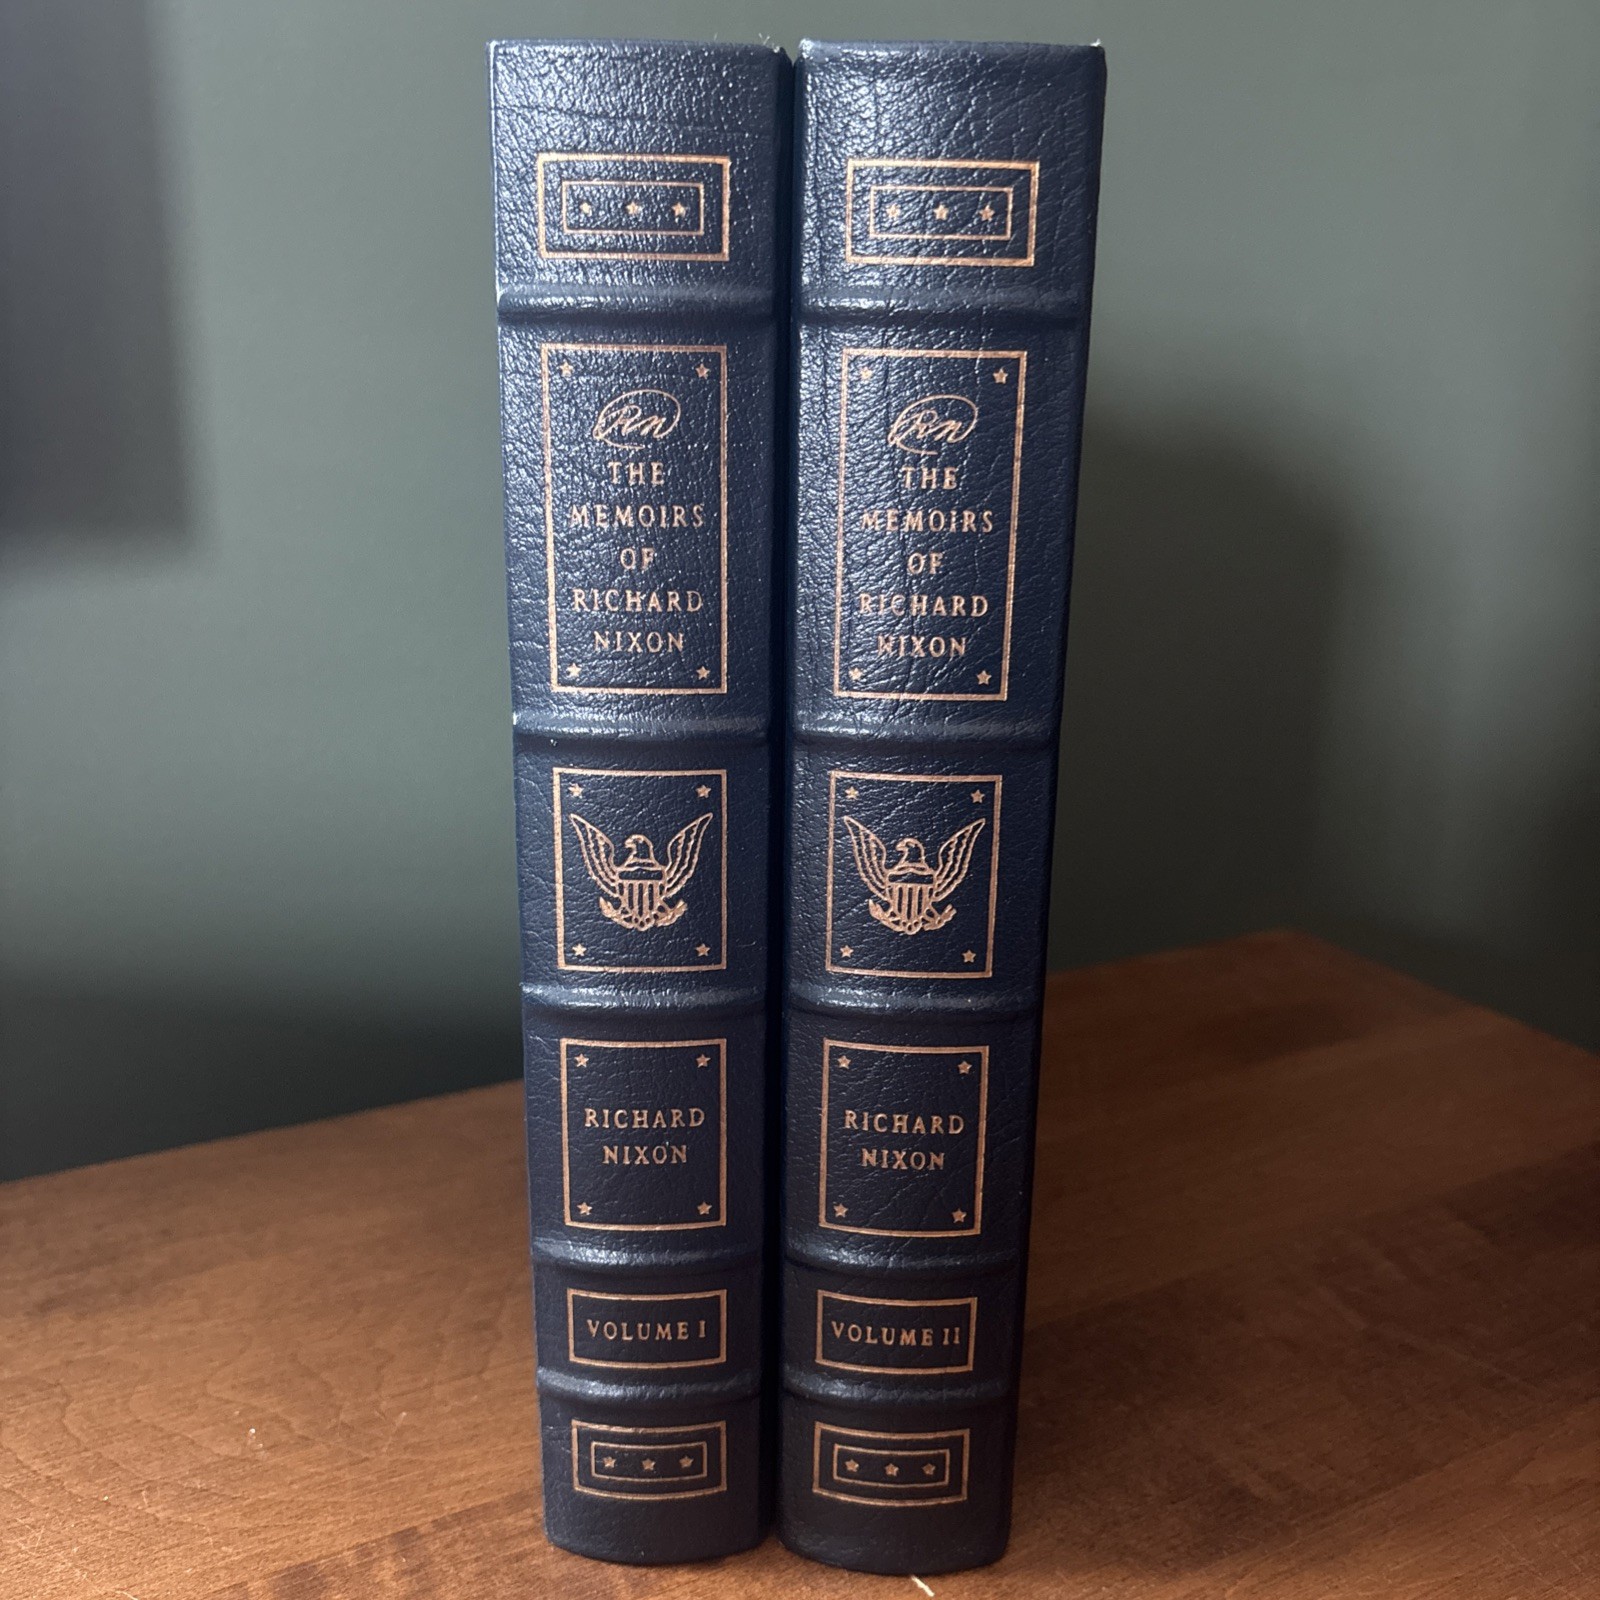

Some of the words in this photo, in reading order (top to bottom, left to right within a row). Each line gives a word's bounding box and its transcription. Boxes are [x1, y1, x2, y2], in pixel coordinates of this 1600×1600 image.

[607, 461, 665, 486] THE
[901, 466, 958, 490] THE
[569, 503, 705, 529] MEMOIRS
[859, 509, 994, 534] MEMOIRS
[620, 546, 656, 571] OF
[906, 552, 943, 575] OF
[572, 588, 704, 613] RICHARD
[858, 593, 990, 618] RICHARD
[593, 630, 685, 653] NIXON
[877, 634, 967, 658] NIXON
[584, 1107, 706, 1130] RICHARD
[843, 1110, 966, 1136] RICHARD
[602, 1144, 688, 1166] NIXON
[861, 1147, 946, 1171] NIXON
[587, 1319, 690, 1341] VOLUME
[698, 1319, 707, 1339] I
[830, 1320, 934, 1347] VOLUME
[943, 1327, 961, 1346] II
